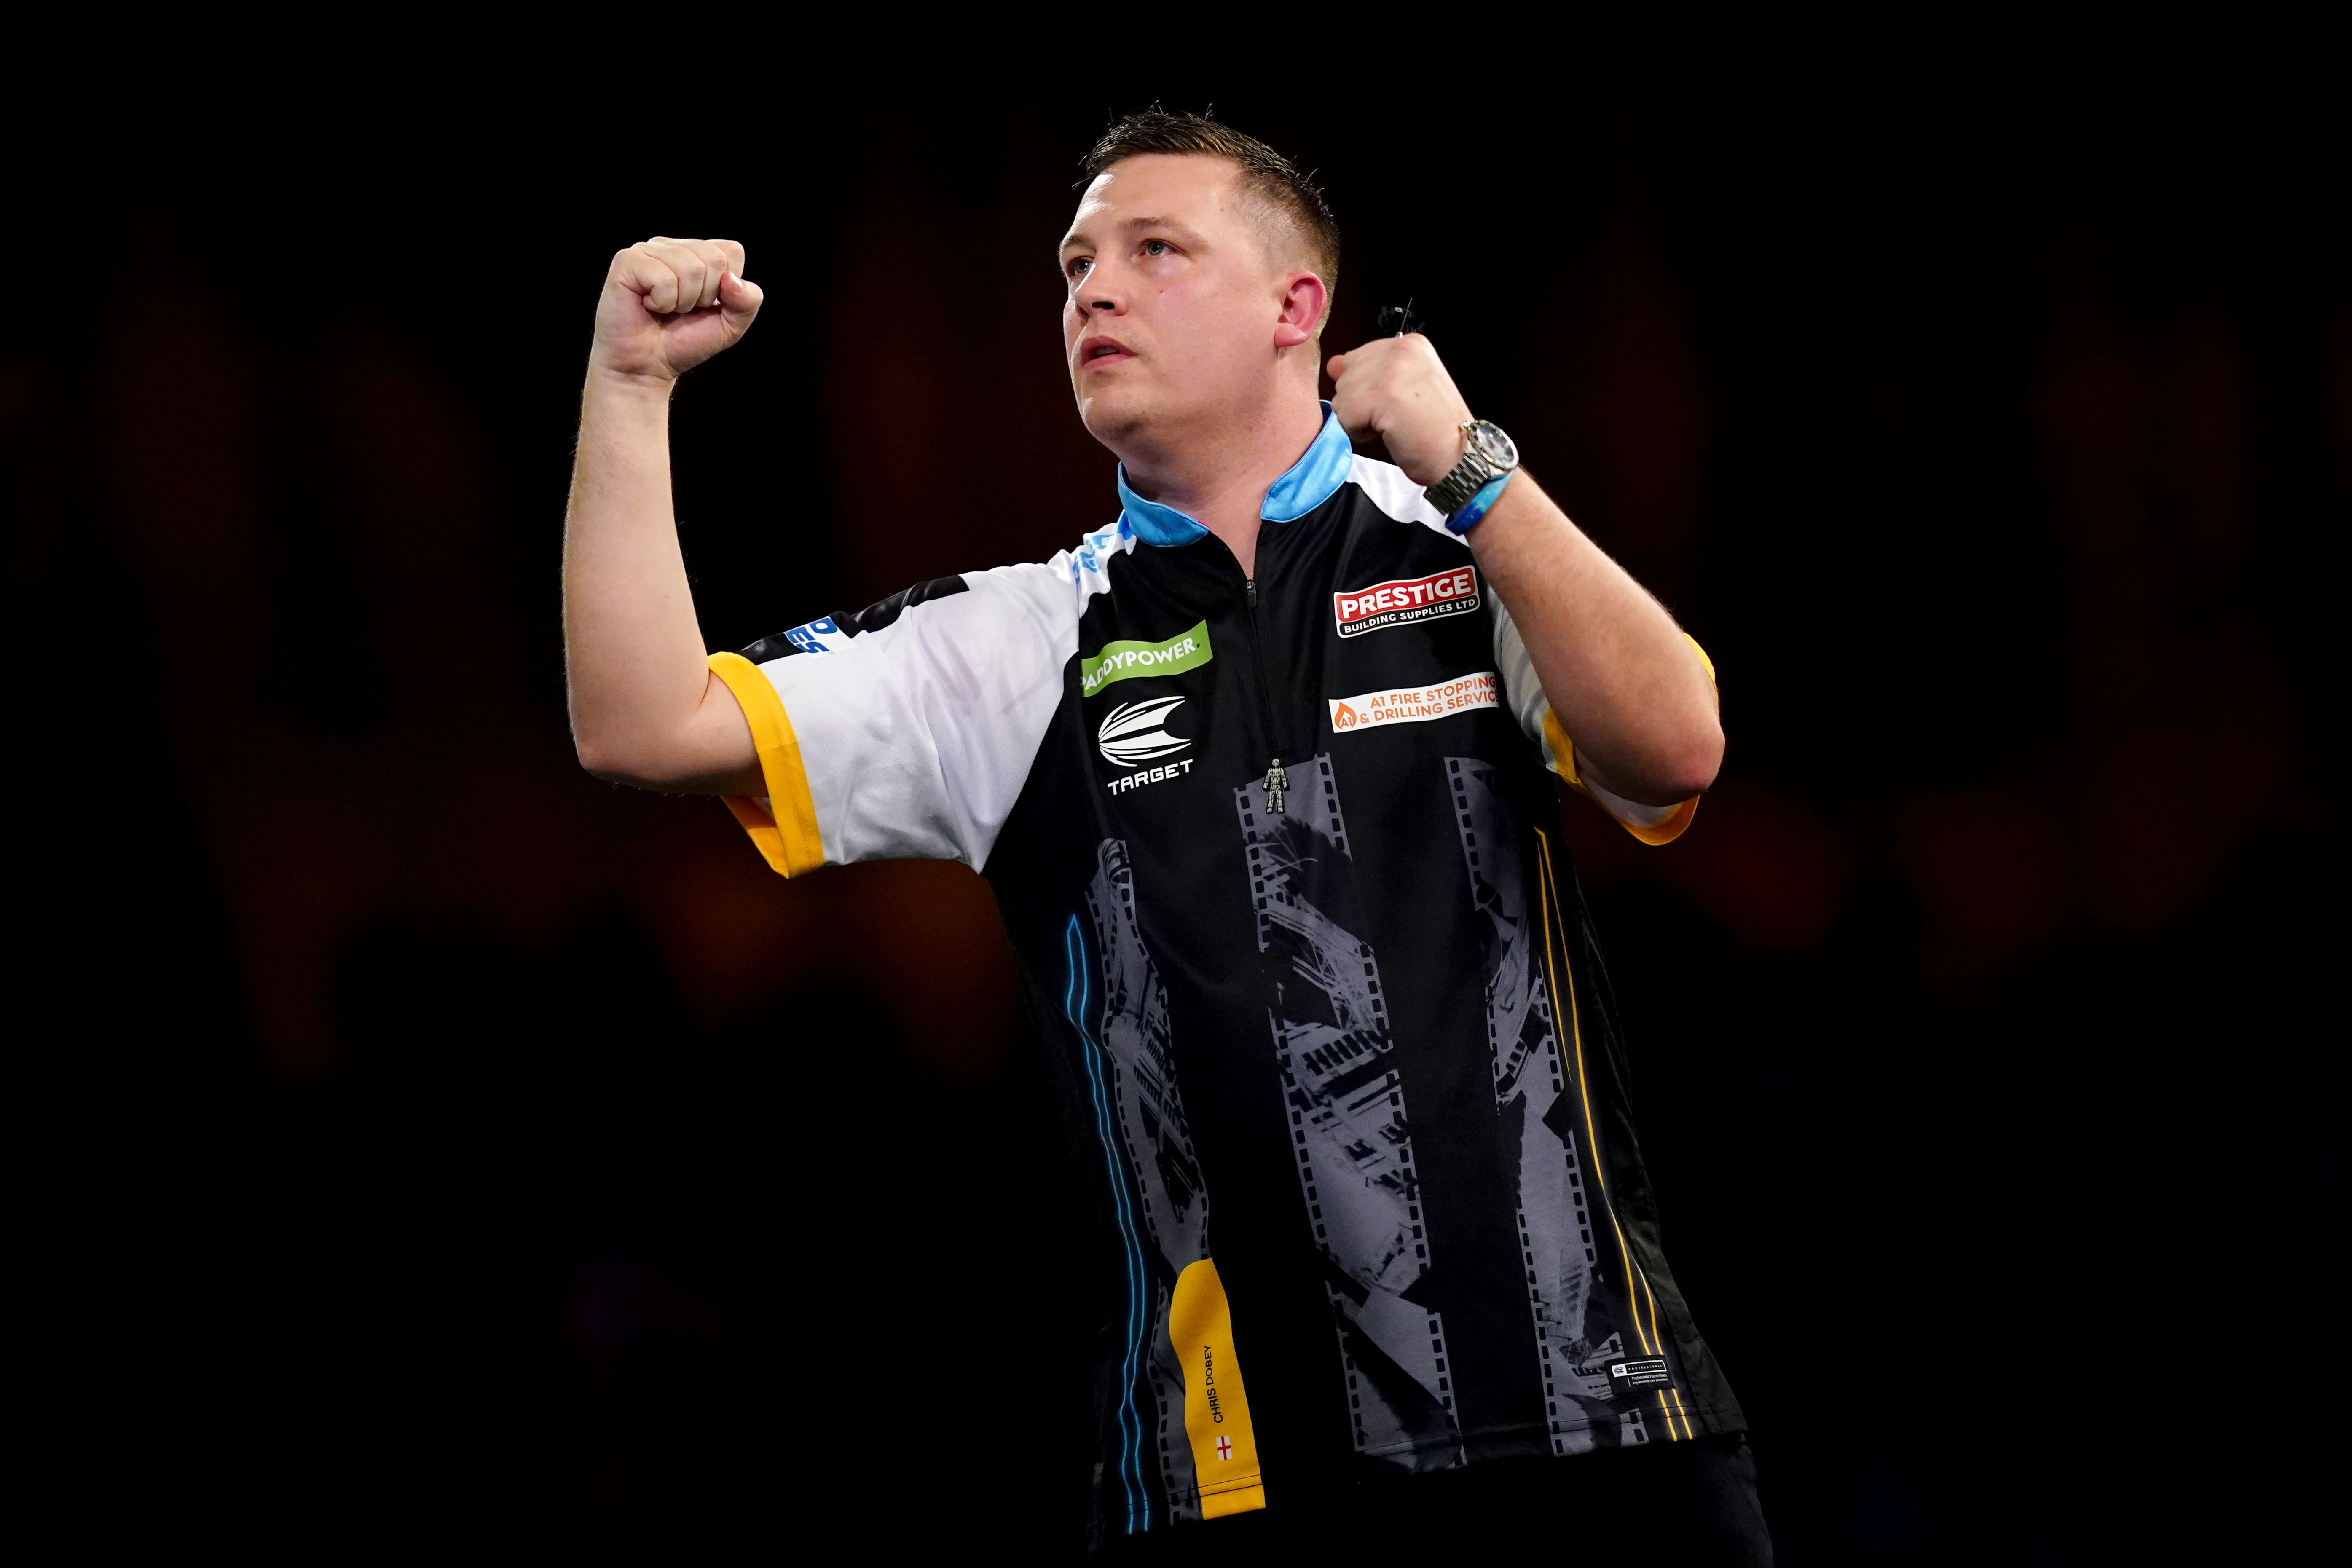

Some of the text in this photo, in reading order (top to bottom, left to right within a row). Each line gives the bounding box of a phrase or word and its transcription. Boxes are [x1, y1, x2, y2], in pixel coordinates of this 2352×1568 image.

[1341, 573, 1472, 619] PRESTIGE
[1344, 598, 1476, 633] BUILDING SUPPLIES LTD
[1371, 675, 1496, 708] A1 FIRE STOPPING
[1360, 713, 1370, 724] &
[1374, 703, 1443, 721] DRILLING
[1108, 759, 1193, 795] TARGET
[1204, 1345, 1223, 1423] CHRIS DOBEY
